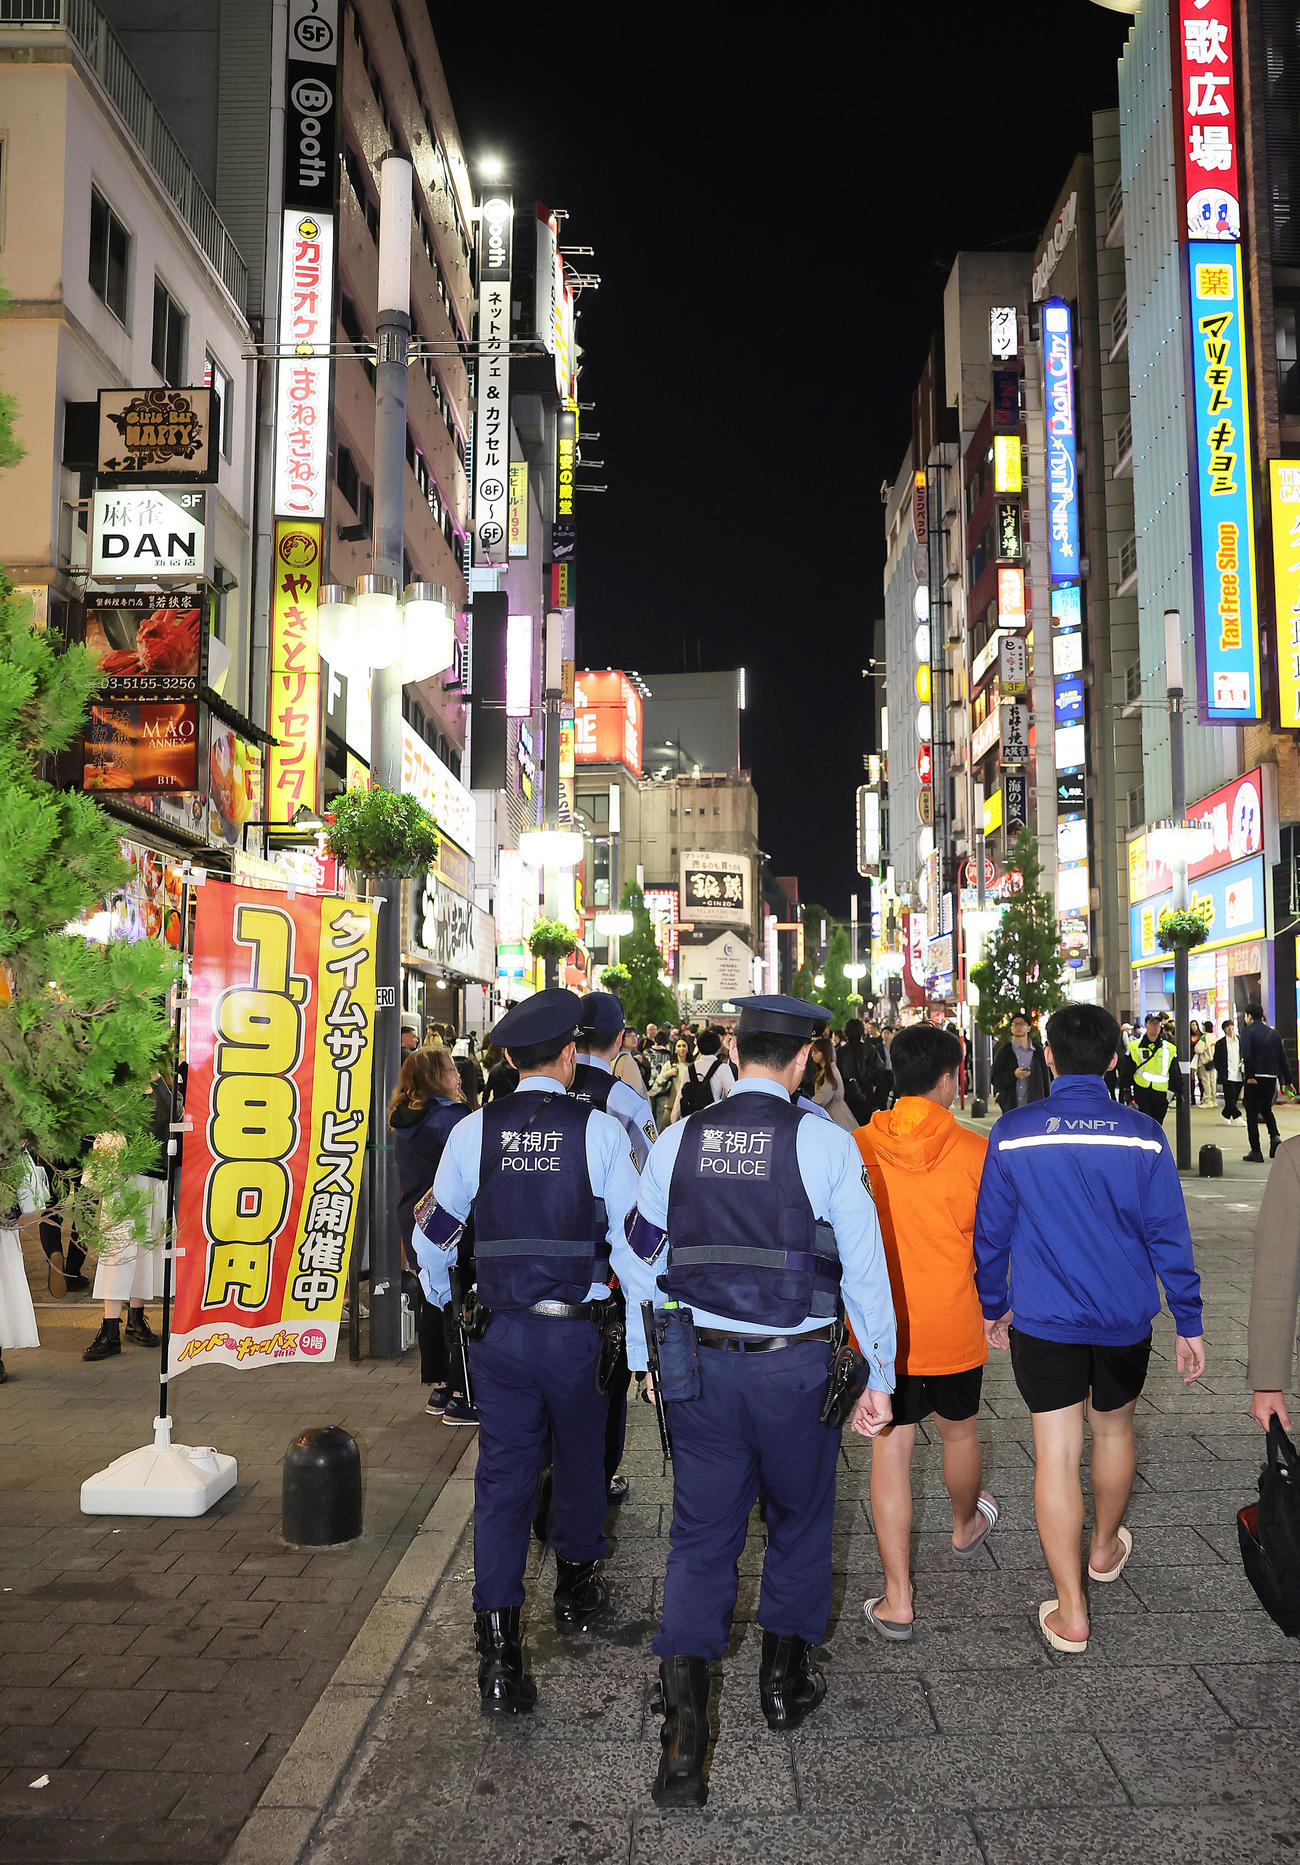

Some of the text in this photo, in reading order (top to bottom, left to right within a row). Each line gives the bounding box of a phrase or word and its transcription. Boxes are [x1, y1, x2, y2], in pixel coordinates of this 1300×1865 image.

[300, 23, 328, 44] 5F
[1184, 0, 1233, 171] 歌広場
[296, 82, 330, 187] Booth
[292, 239, 321, 340] カラオケ
[1201, 269, 1230, 296] 薬
[486, 385, 501, 400] &
[1201, 313, 1237, 494] マツモトキヨシ
[126, 424, 193, 446] HAPPY
[288, 366, 317, 513] まねきねこ
[485, 405, 500, 467] カプセル
[121, 456, 149, 471] 2F
[483, 481, 501, 498] 8F
[509, 467, 520, 506] 生ビール
[1050, 449, 1069, 542] SHINJUKU
[102, 499, 164, 528] 麻雀
[180, 494, 202, 508] 3F
[102, 532, 196, 559] DAN
[482, 525, 501, 542] 5F
[1218, 525, 1241, 650] Tax Free Shop
[101, 677, 196, 690] 03-5155-3256
[1007, 682, 1021, 692] 3F
[279, 572, 313, 822] やきとりセンター
[90, 706, 114, 725] 1F
[142, 719, 195, 738] MAO
[149, 737, 187, 749] ANNEX
[157, 775, 177, 785] B1F
[1008, 779, 1022, 817] 海の家
[912, 917, 923, 959] トラノコ
[376, 988, 395, 1006] ERO
[202, 904, 311, 1311] 1,980円
[291, 908, 371, 1311] タイムサービス開催中
[1064, 1119, 1119, 1131] VNPT
[500, 1129, 564, 1154] 警視庁
[700, 1128, 773, 1156] 警視庁
[501, 1156, 561, 1172] POLICE
[700, 1157, 767, 1177] POLICE
[301, 1335, 325, 1351] 9階
